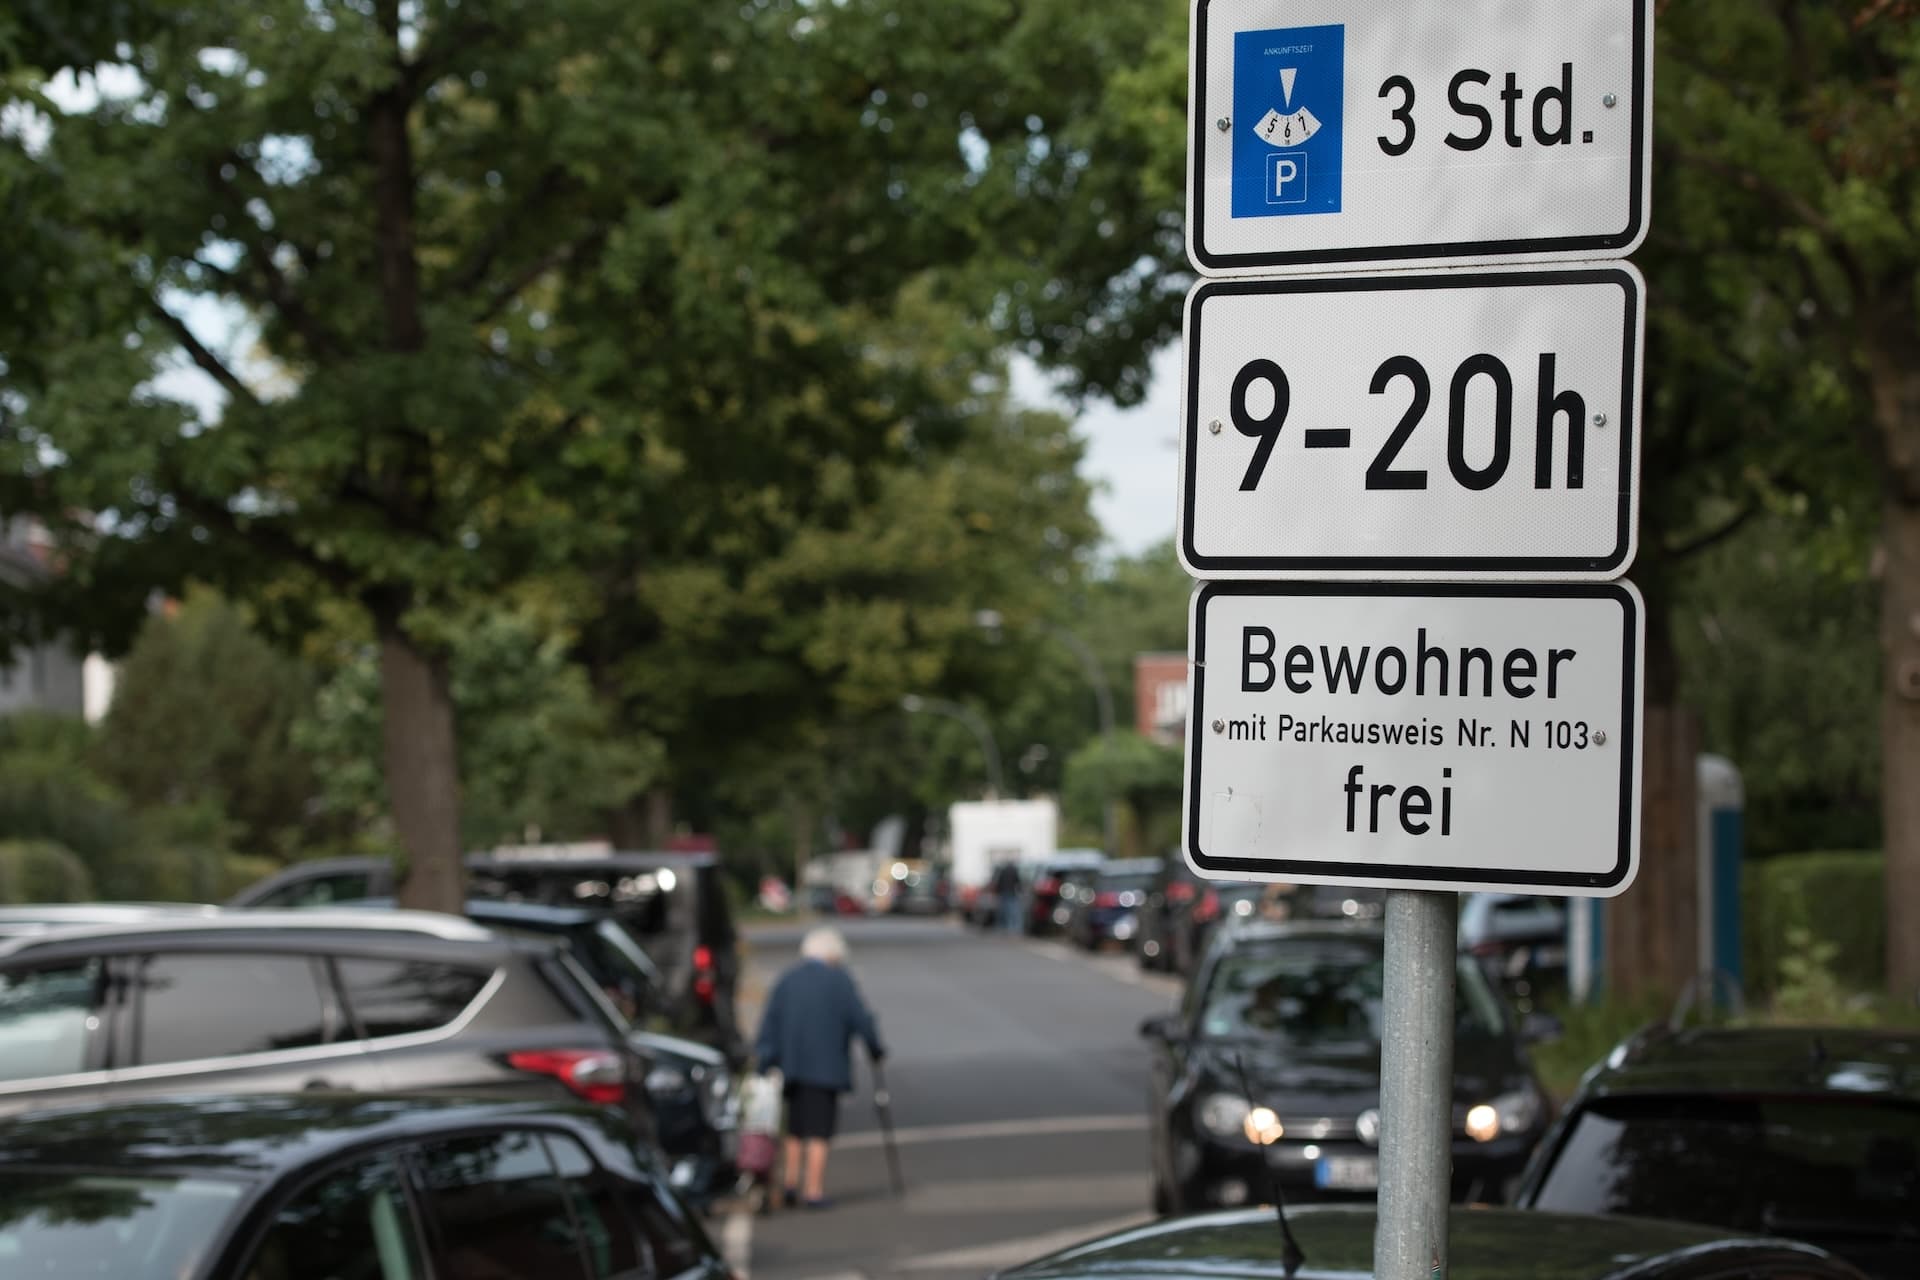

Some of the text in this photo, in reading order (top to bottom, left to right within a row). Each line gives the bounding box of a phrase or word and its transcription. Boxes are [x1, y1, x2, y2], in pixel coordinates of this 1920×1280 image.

[1263, 44, 1313, 56] ANKUNFTSZEIT
[1267, 117, 1278, 134] 5
[1284, 121, 1291, 138] 6
[1298, 115, 1306, 132] 7
[1377, 62, 1594, 157] 3 Std.
[1275, 159, 1297, 197] P
[1229, 352, 1586, 492] 9-20h
[1241, 625, 1577, 699] Bewohner
[1228, 713, 1590, 750] mit Parkausweis Nr. N 103
[1343, 764, 1452, 836] frei
